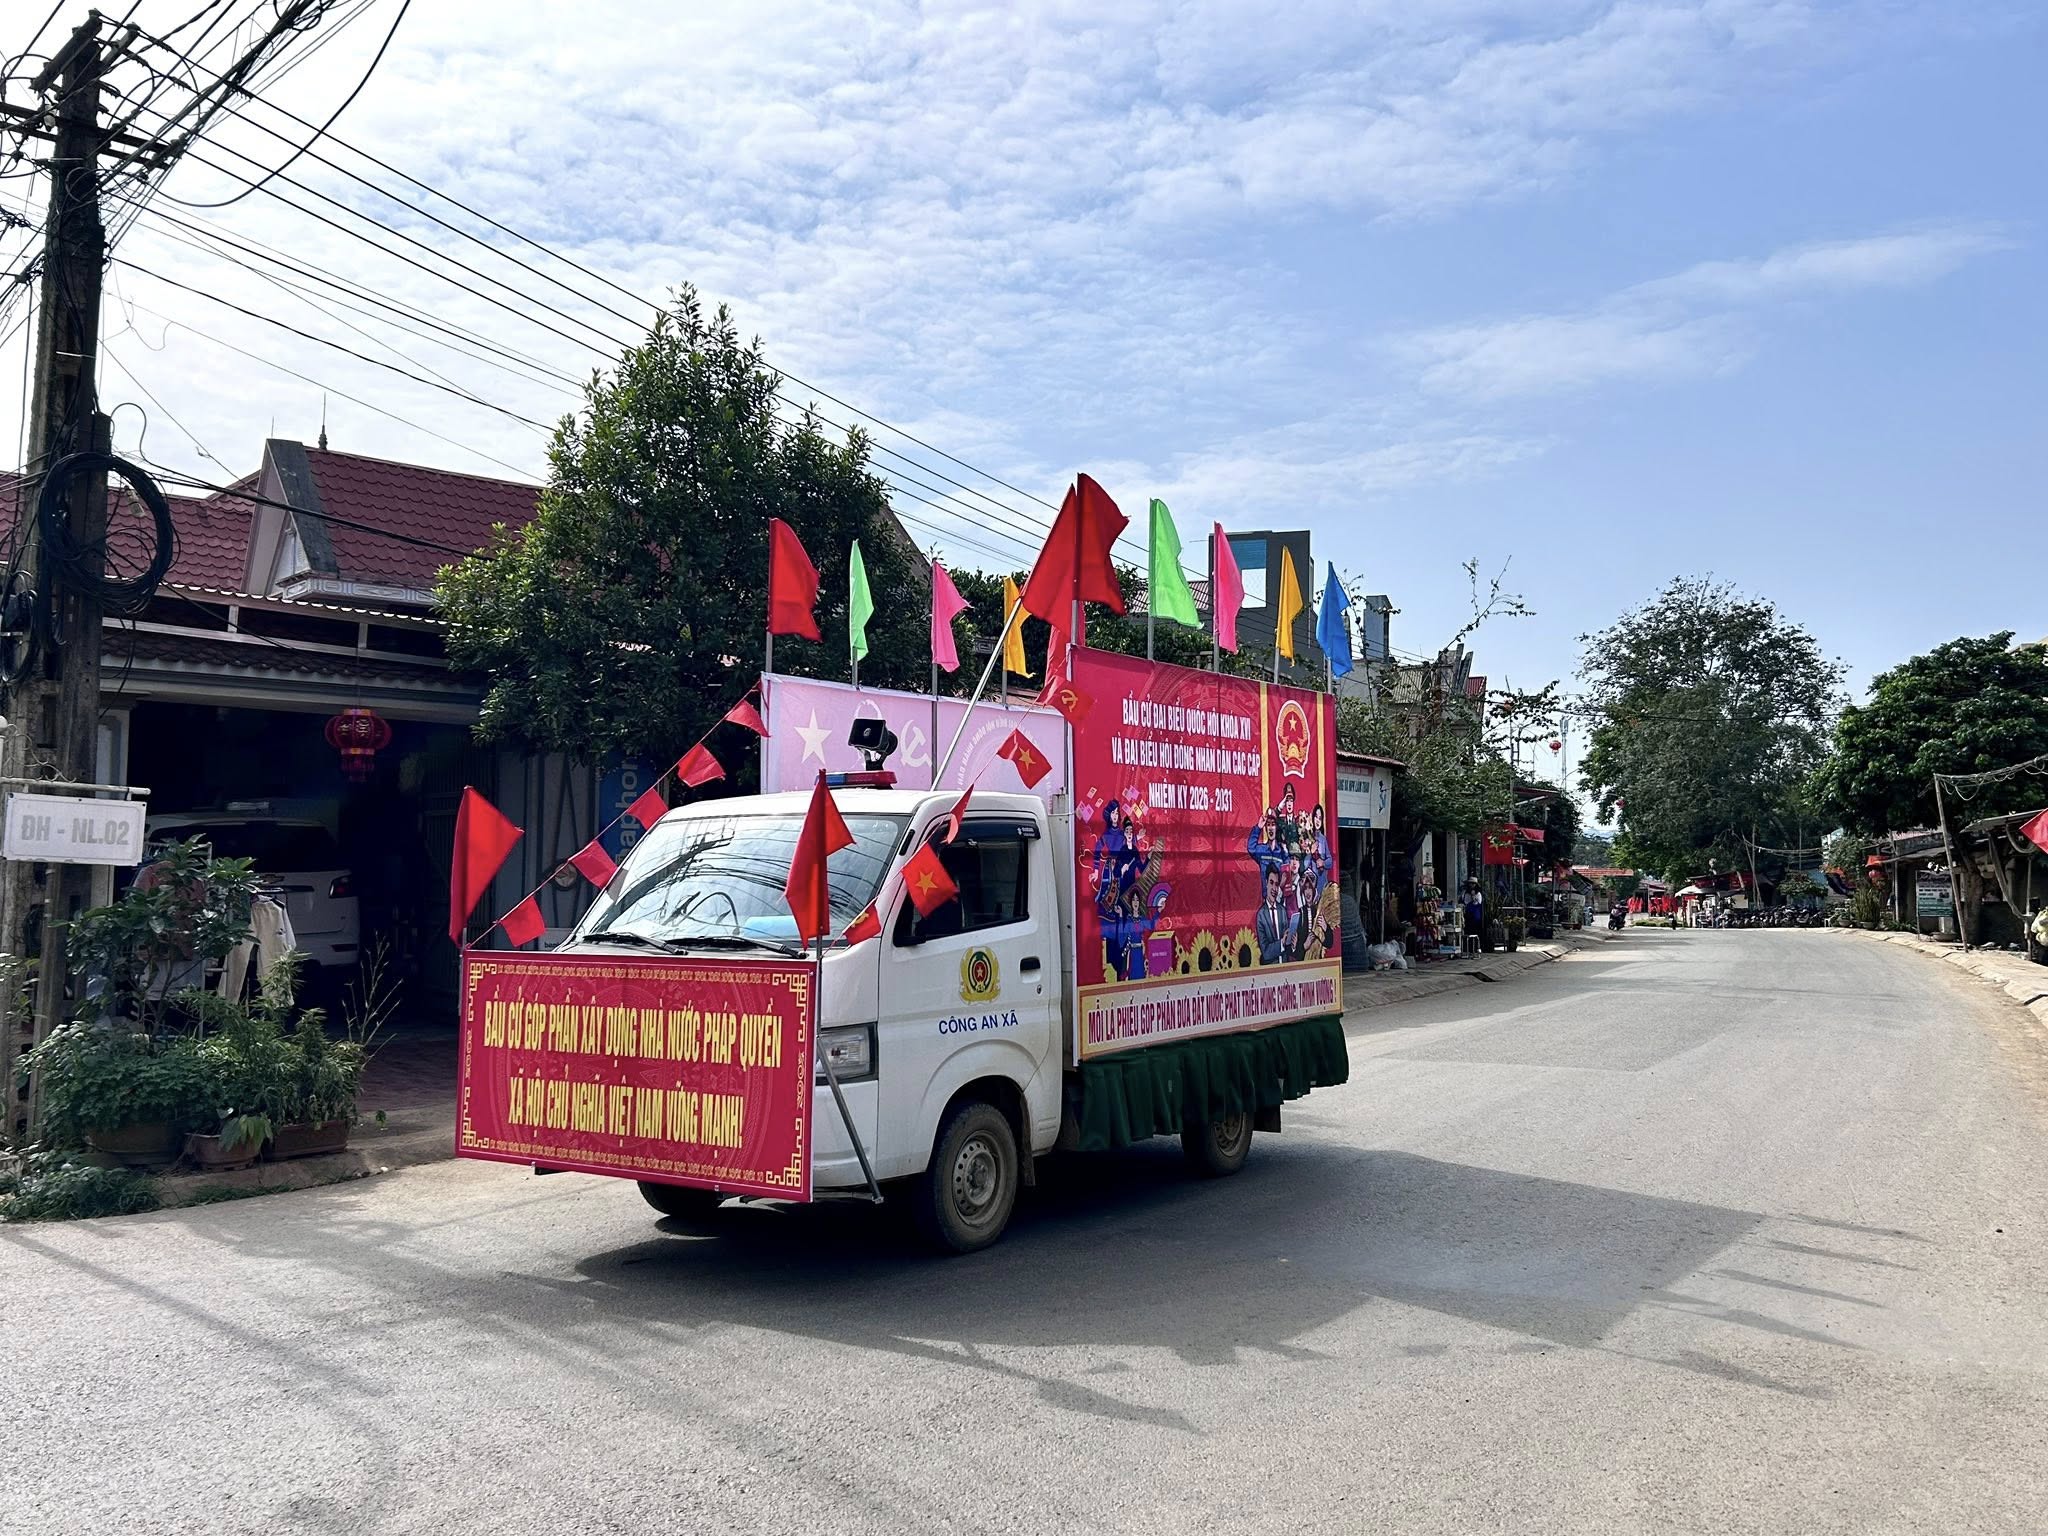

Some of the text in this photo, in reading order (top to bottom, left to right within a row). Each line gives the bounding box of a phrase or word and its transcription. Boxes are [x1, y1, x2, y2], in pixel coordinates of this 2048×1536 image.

[1123, 690, 1251, 742] BẦU CỬ ĐẠI BIỂU QUỐC HỘI KHÓA XVI
[1112, 731, 1260, 777] VÀ ĐẠI BIỂU HỘI ĐỒNG NHÂN DÂN CÁC CẤP
[1149, 778, 1176, 814] NHIỆM
[1178, 780, 1188, 810] KỲ
[1190, 786, 1208, 811] 2026
[1215, 788, 1232, 812] 2031
[21, 815, 51, 842] ĐH
[72, 818, 130, 846] NL.02
[484, 985, 782, 1072] BẦU CỬ GÓP PHẦN XÂY DỰNG NHÀ NƯỚC PHÁP QUYỀN
[938, 1010, 1018, 1034] CÔNG AN XÃ
[1088, 999, 1104, 1044] MỖI
[1106, 1002, 1116, 1041] LÁ
[1117, 995, 1138, 1039] PHIẾU
[1140, 996, 1155, 1035] GÓP
[1157, 990, 1176, 1032] PHẦN
[1177, 995, 1190, 1028] ĐƯA
[1192, 986, 1205, 1026] ĐẤT
[1206, 988, 1224, 1023] NƯỚC
[1224, 986, 1240, 1020] PHÁT
[1242, 978, 1259, 1018] TRIỂN
[508, 1064, 744, 1158] XÃ HỘI CHỦ NGHĨA VIỆT NAM VỮNG MẠNH!
